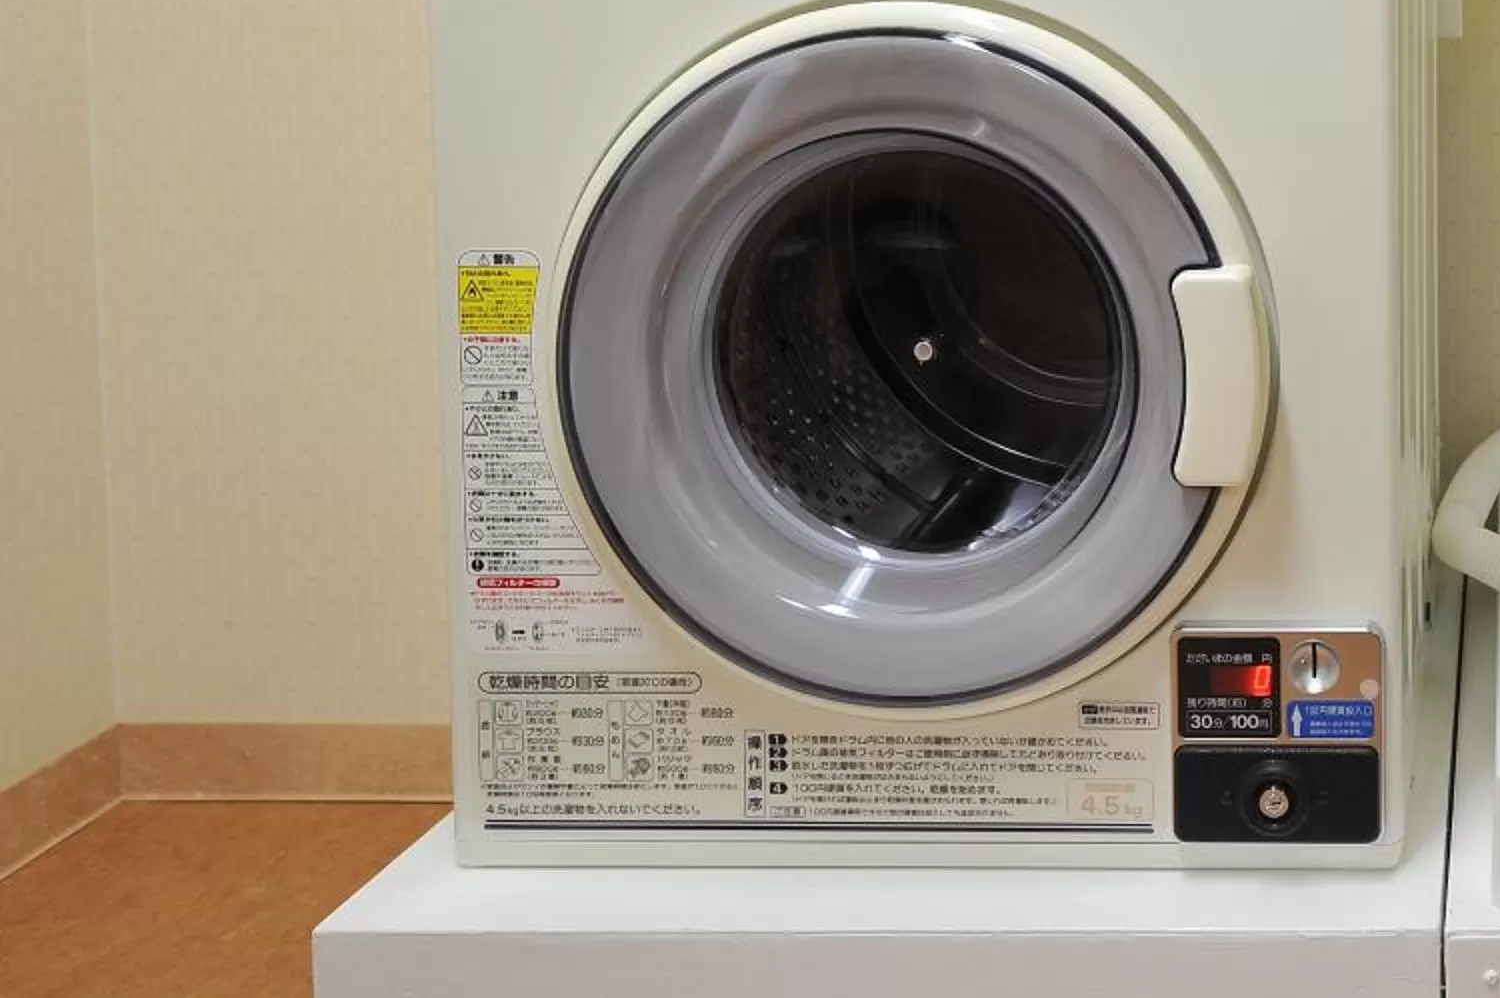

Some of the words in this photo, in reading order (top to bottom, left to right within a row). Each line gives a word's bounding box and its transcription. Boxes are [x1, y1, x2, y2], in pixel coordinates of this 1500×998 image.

[489, 675, 610, 690] 乾燥時間の目安
[1252, 665, 1272, 697] 0
